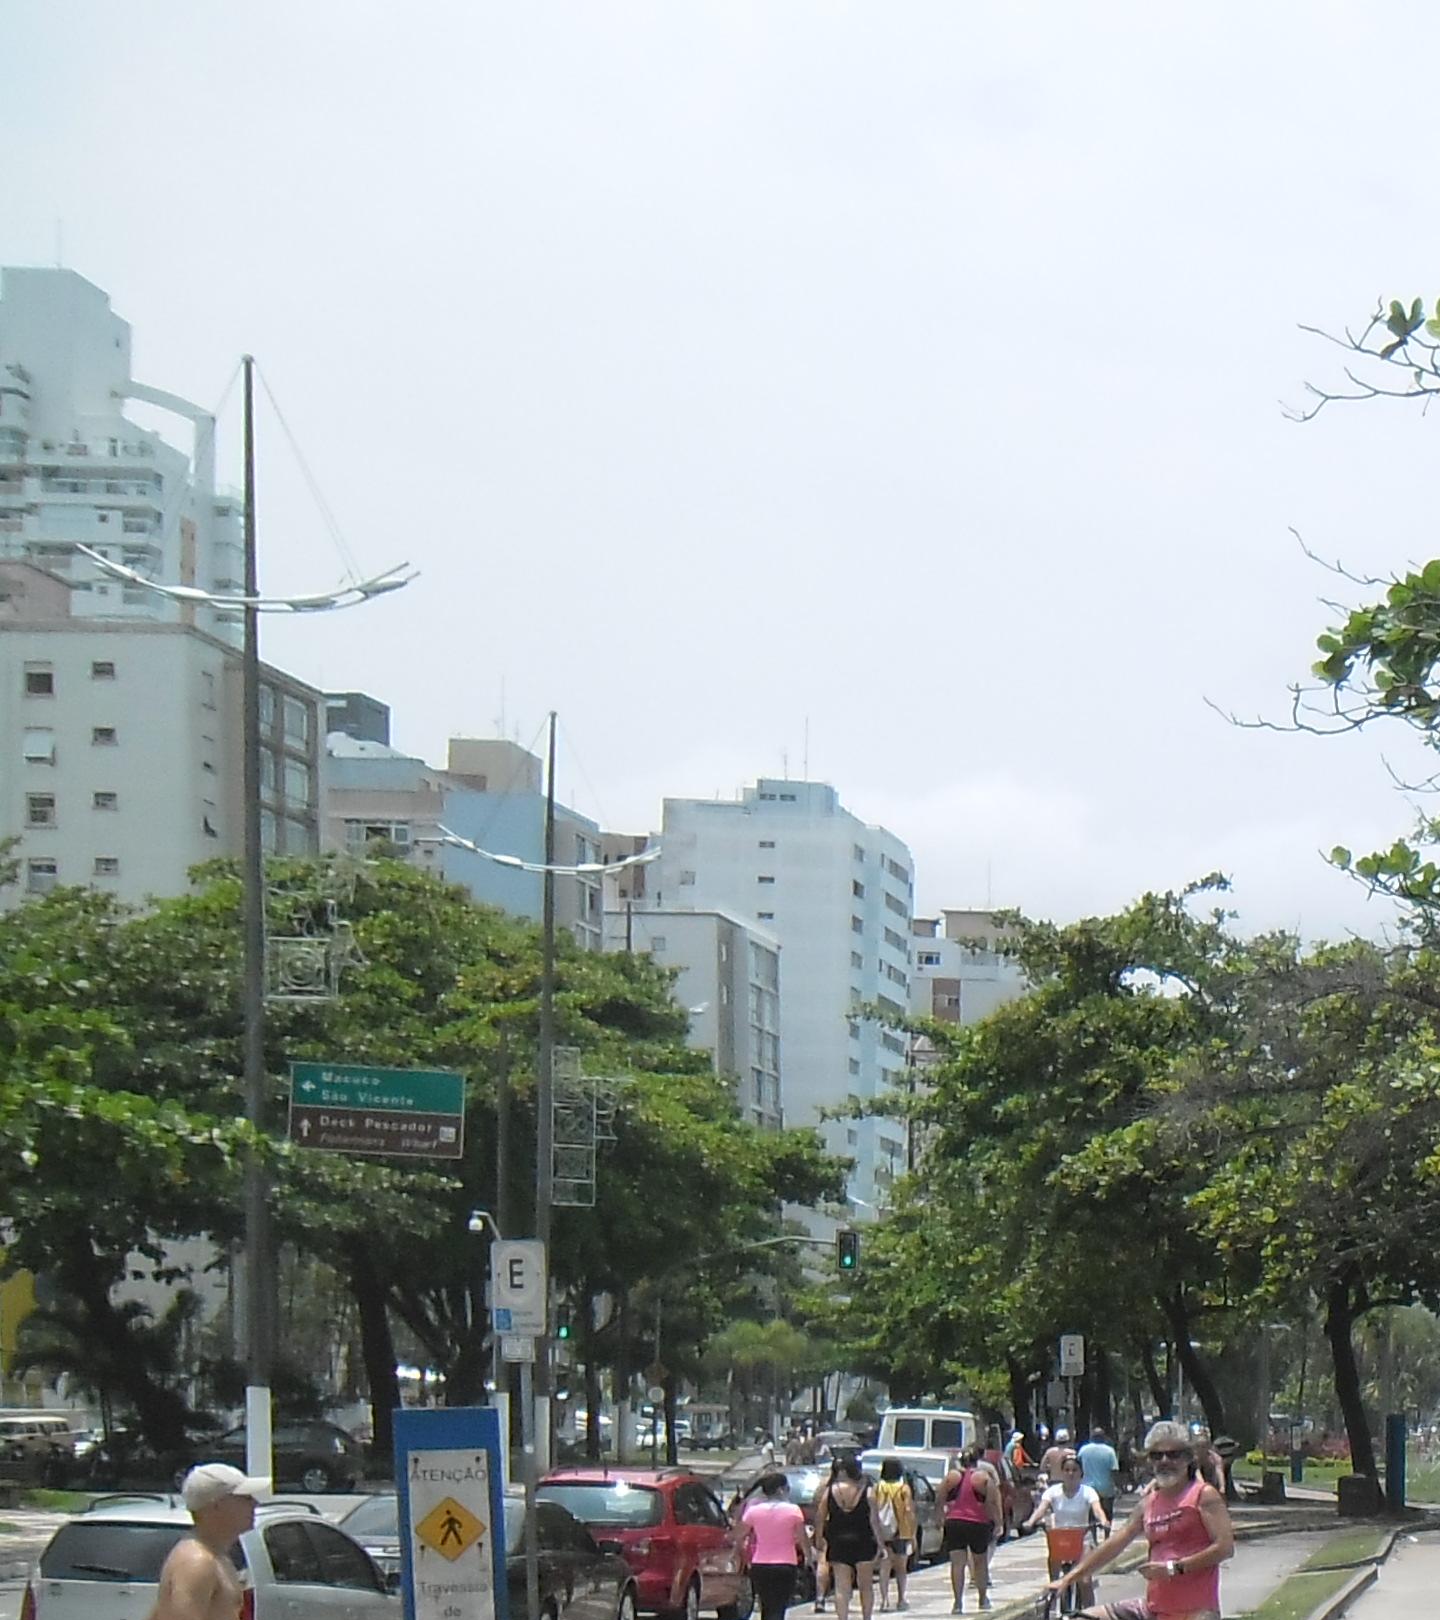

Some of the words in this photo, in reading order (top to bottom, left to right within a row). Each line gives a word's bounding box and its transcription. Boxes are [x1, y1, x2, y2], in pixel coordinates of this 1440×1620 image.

[509, 1258, 524, 1289] E
[410, 1467, 487, 1484] ATENÇÃO
[419, 1582, 489, 1594] Travessia
[443, 1606, 462, 1617] de
